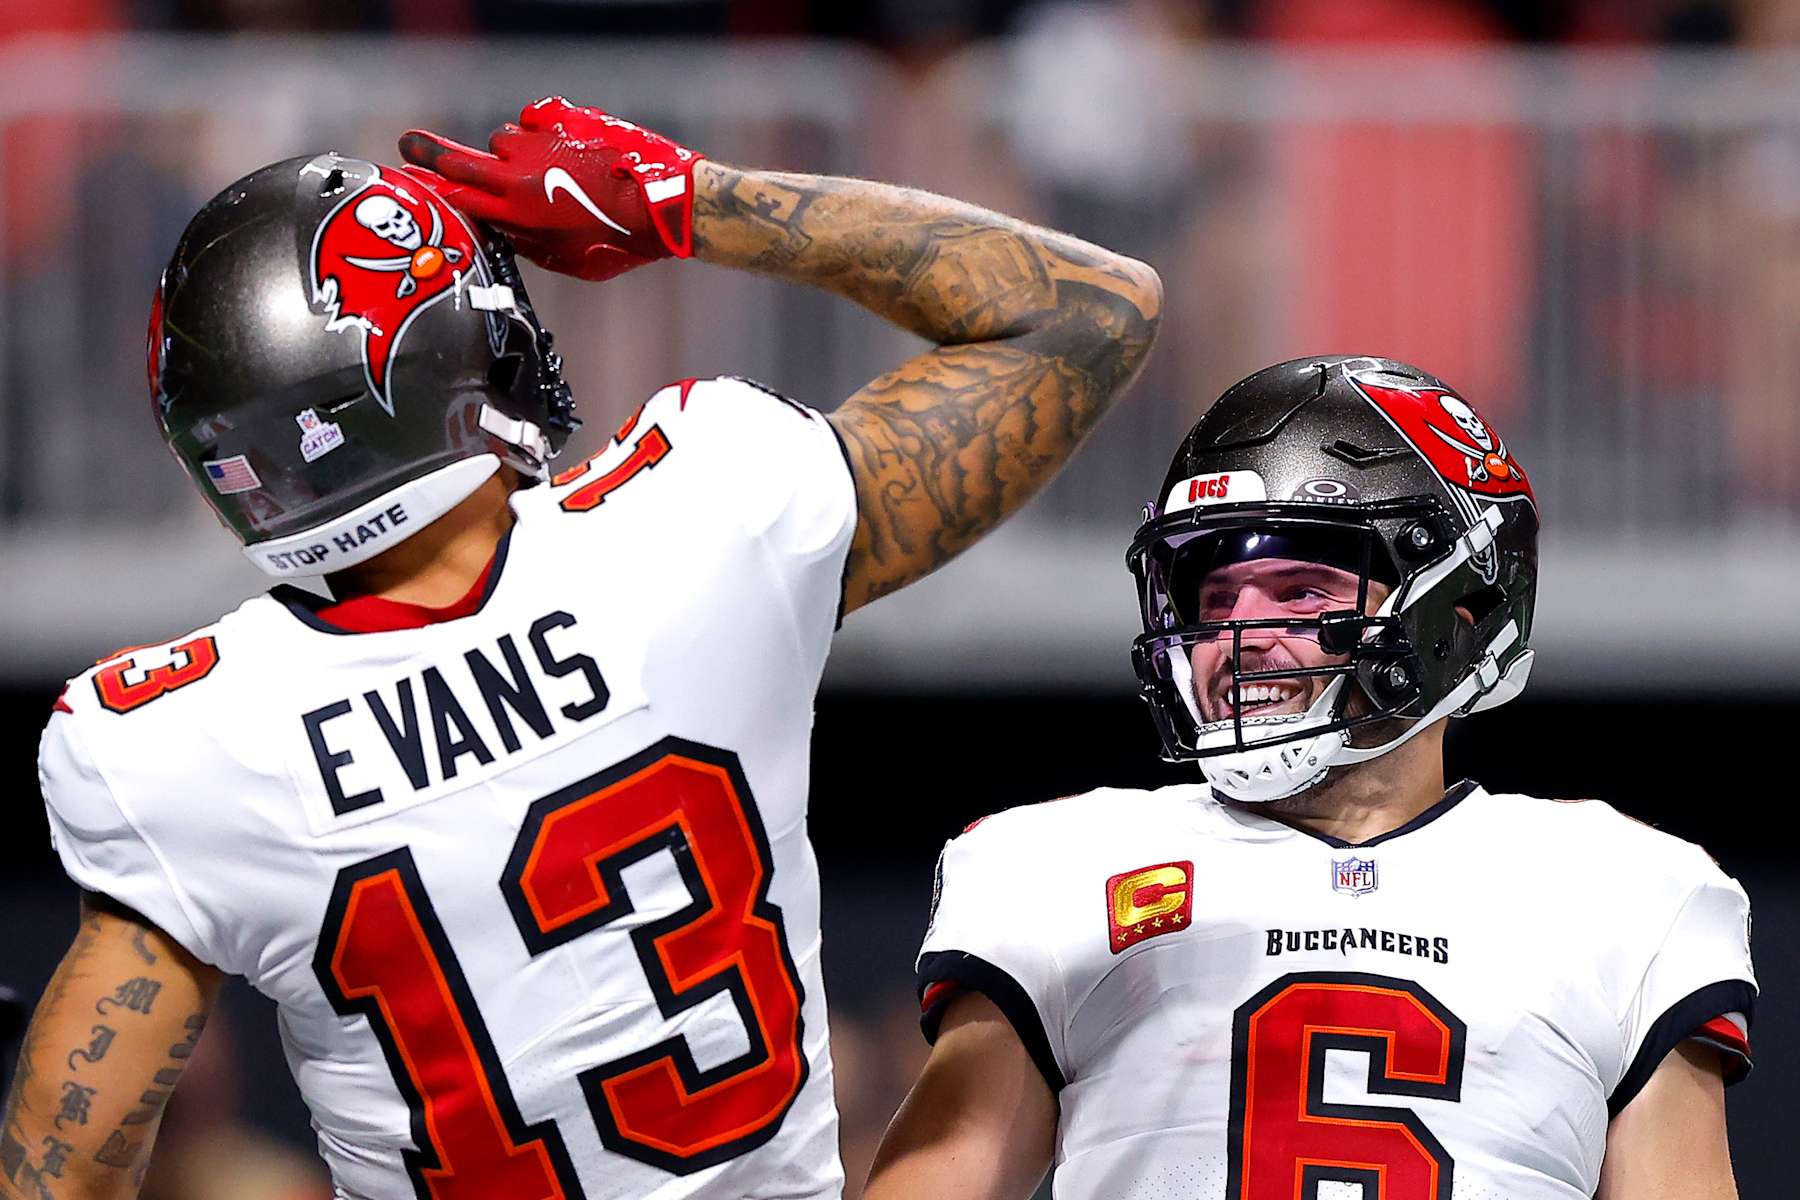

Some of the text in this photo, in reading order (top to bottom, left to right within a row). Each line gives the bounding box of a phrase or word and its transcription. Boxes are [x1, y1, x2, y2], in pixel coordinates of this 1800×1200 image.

[304, 427, 339, 455] CATCH
[266, 503, 408, 570] STOP HATE
[302, 610, 610, 817] EVANS
[1113, 866, 1187, 928] C
[1340, 872, 1371, 888] NFL
[312, 736, 810, 1200] 13
[1265, 928, 1449, 965] BUCCANEERS
[1225, 971, 1468, 1200] 6
